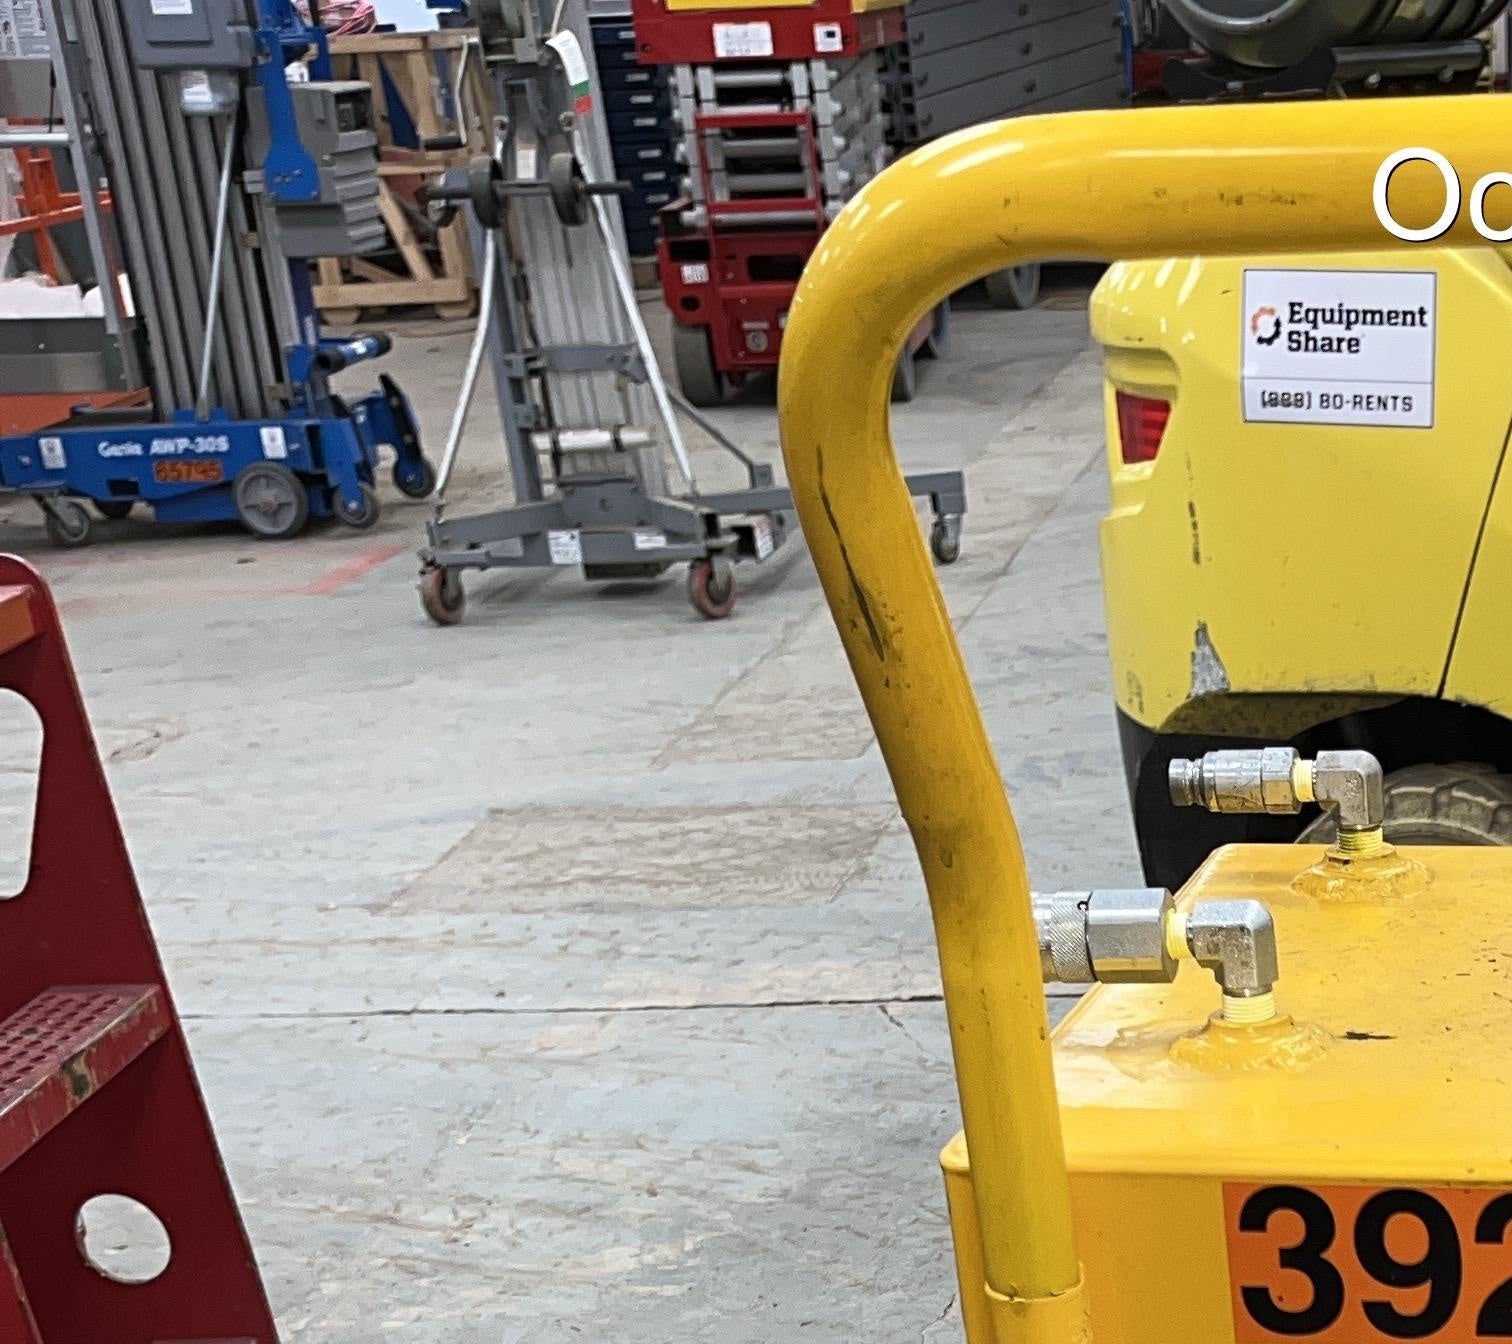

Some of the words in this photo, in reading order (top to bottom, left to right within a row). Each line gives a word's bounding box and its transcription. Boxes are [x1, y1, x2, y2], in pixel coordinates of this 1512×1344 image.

[1288, 301, 1428, 331] Equipment
[1287, 330, 1362, 354] Share
[1261, 389, 1313, 410] (888)
[1319, 393, 1414, 413] 80-RENTS
[149, 435, 230, 456] AWP-30S
